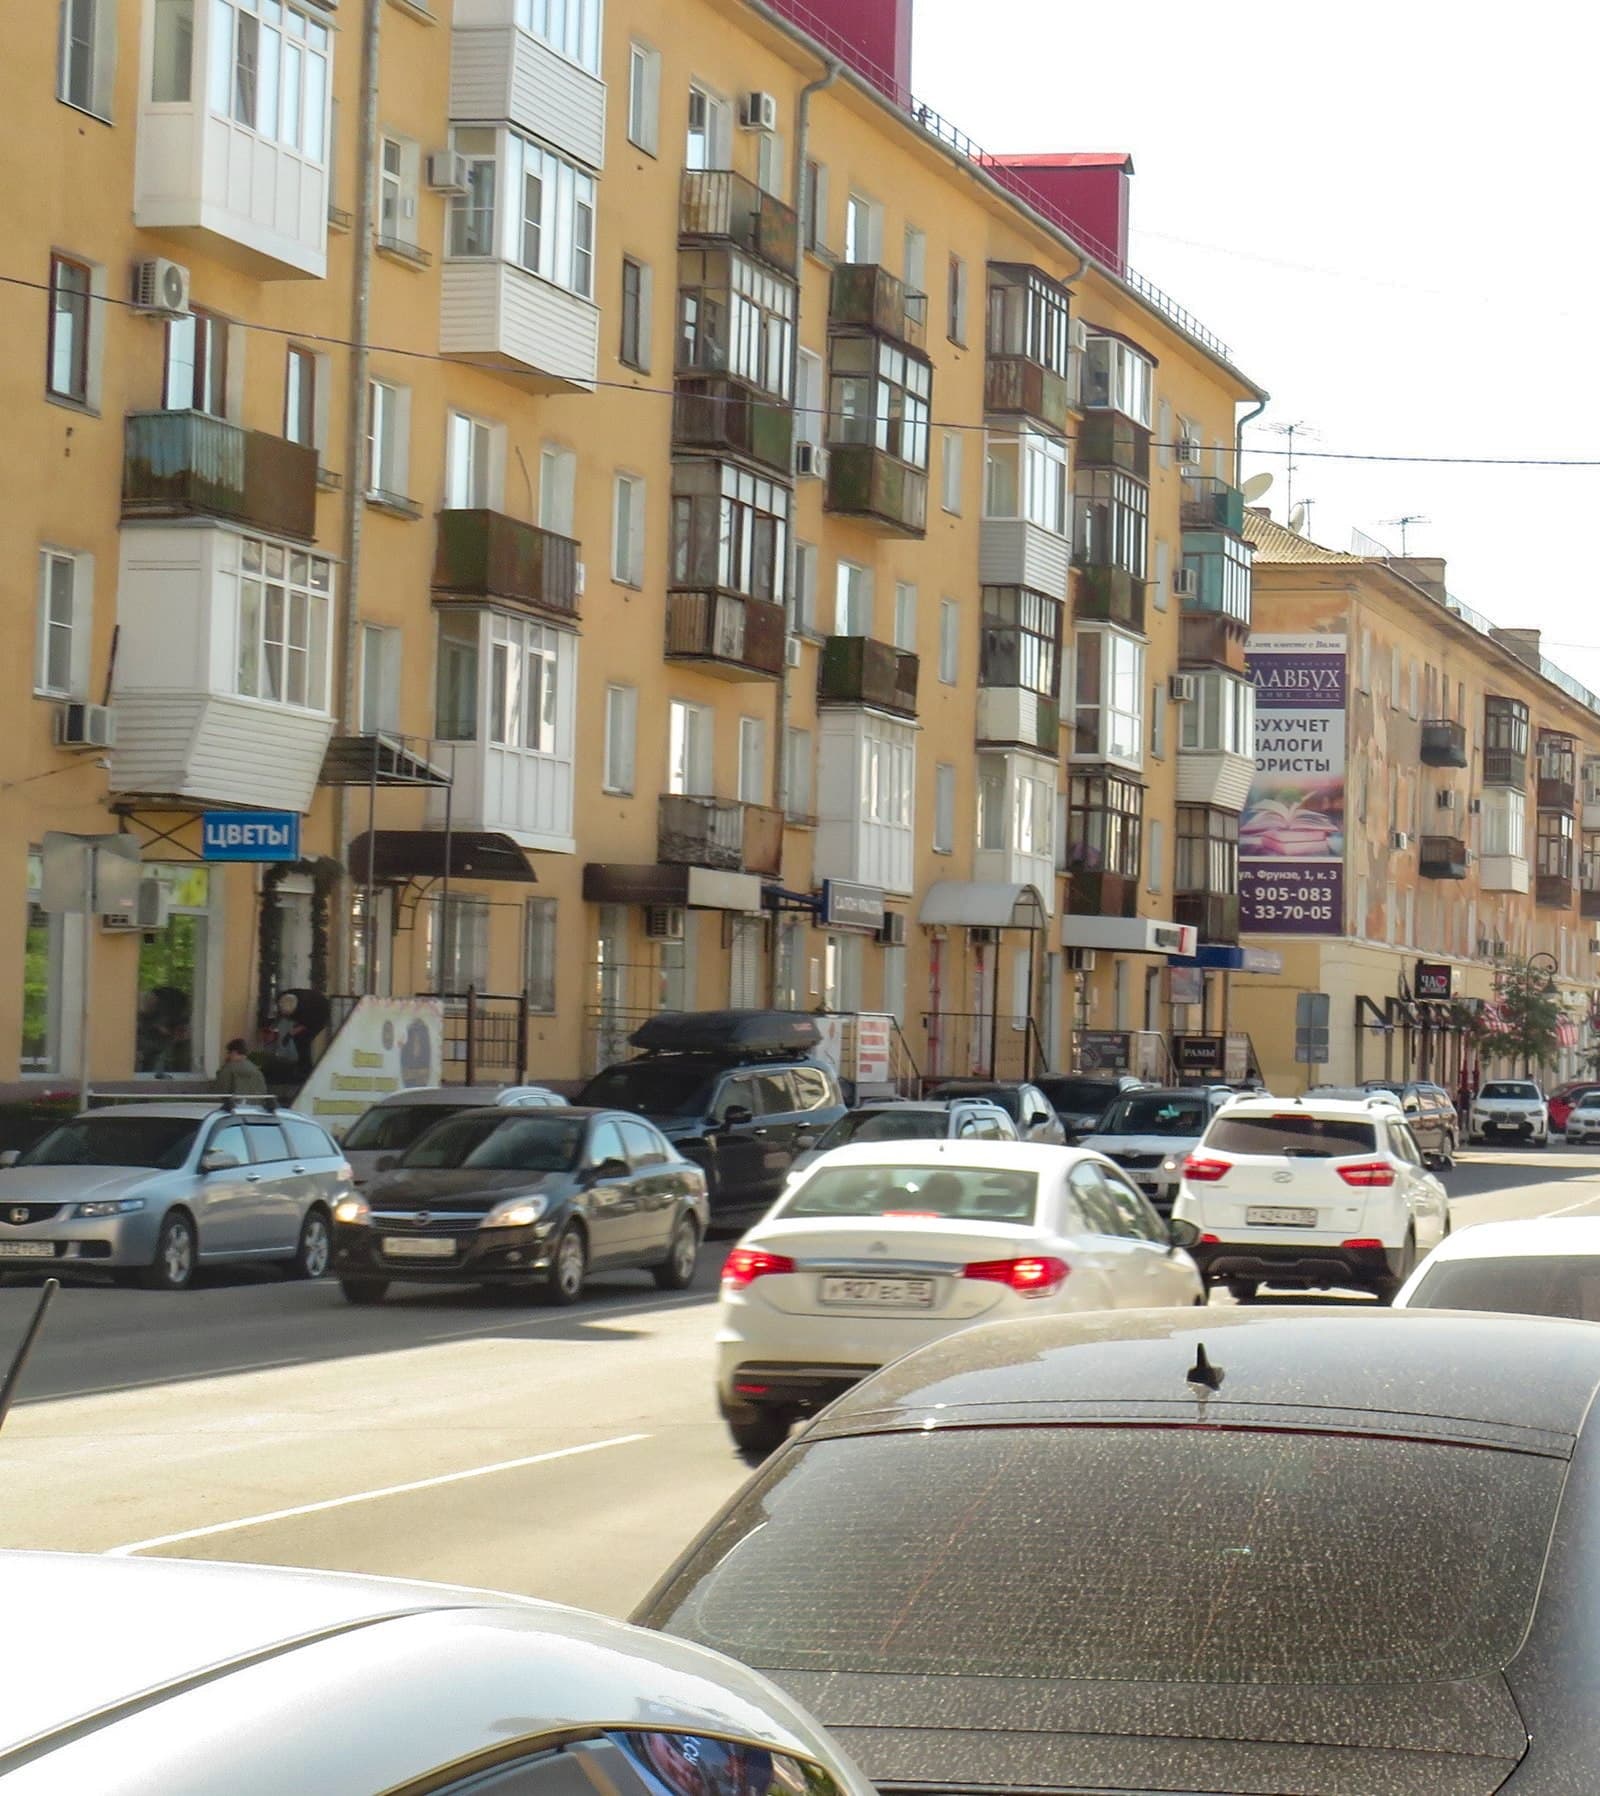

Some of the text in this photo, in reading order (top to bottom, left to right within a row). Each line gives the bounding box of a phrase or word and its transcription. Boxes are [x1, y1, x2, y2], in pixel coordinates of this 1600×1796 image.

[1252, 668, 1341, 692] ЛАВБУХ
[207, 823, 289, 848] ЦВЕТЫ
[1238, 871, 1255, 880] ул.
[1304, 870, 1314, 880] 1,
[1329, 870, 1337, 880] 3
[1255, 887, 1332, 901] 905-083
[1254, 905, 1332, 920] 33-70-05
